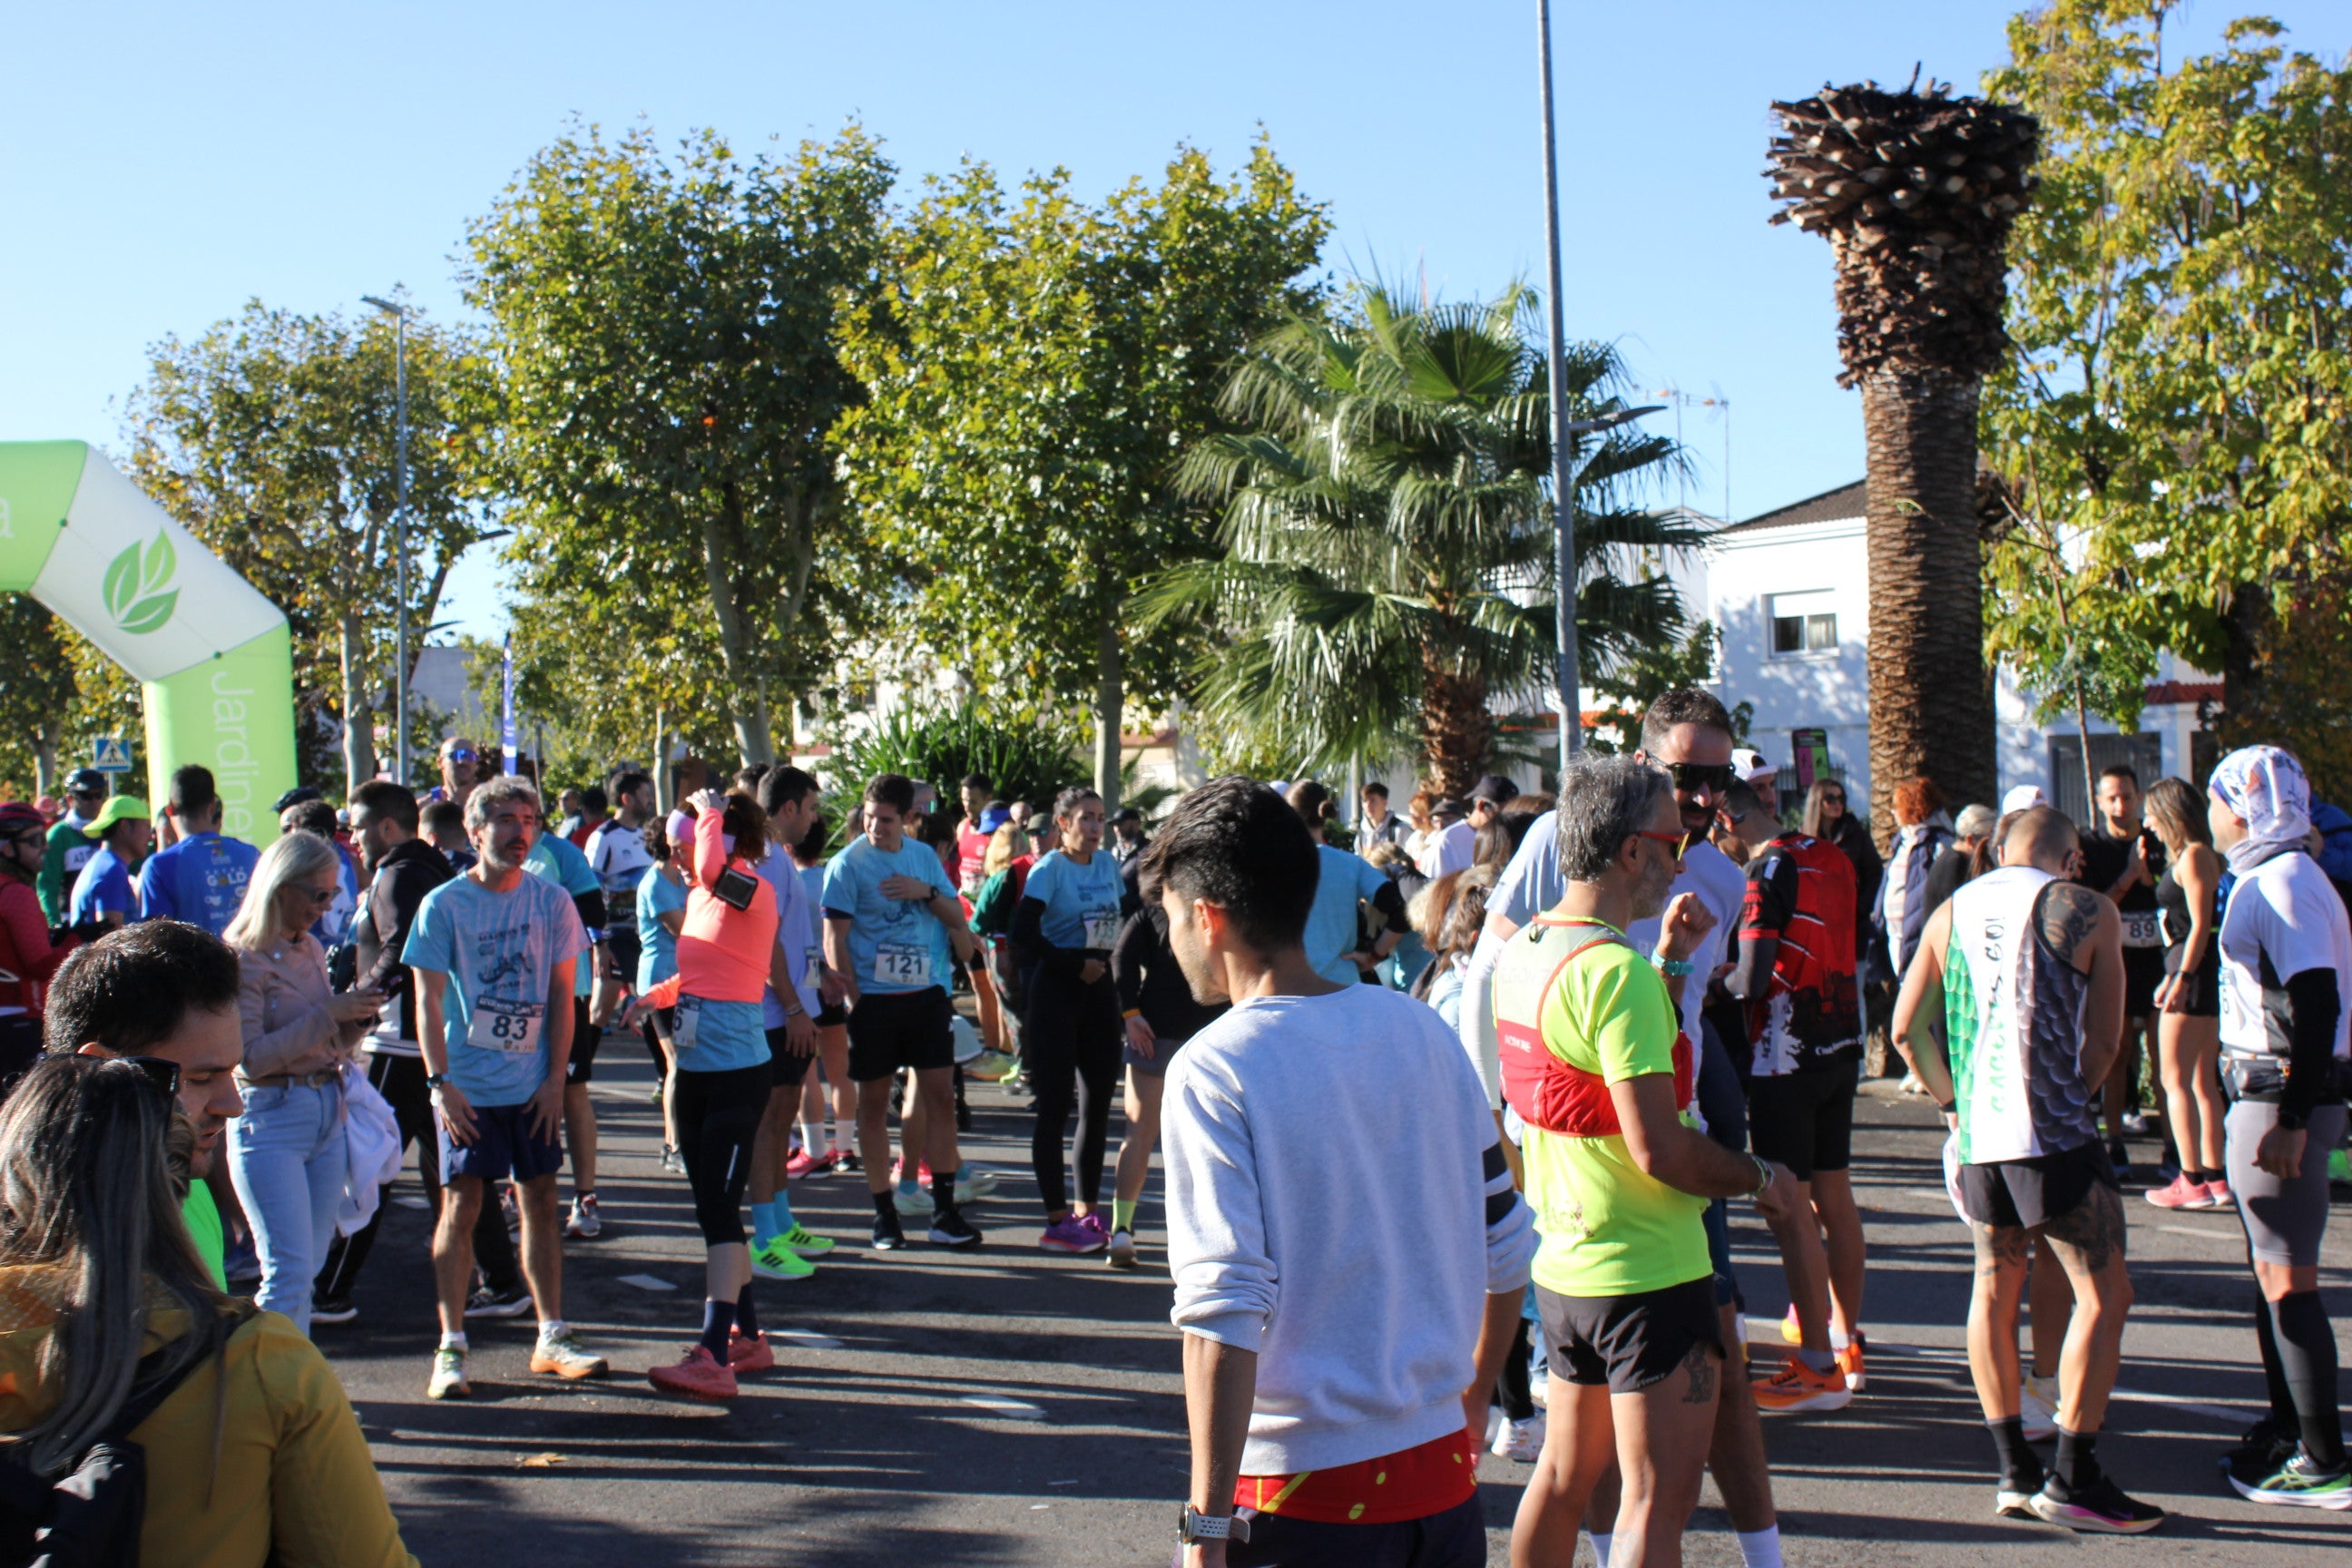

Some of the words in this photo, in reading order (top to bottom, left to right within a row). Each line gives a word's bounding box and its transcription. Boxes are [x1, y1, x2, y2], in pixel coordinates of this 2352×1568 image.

[2129, 920, 2155, 939] 89
[884, 955, 923, 975] 121
[491, 1014, 529, 1041] 83
